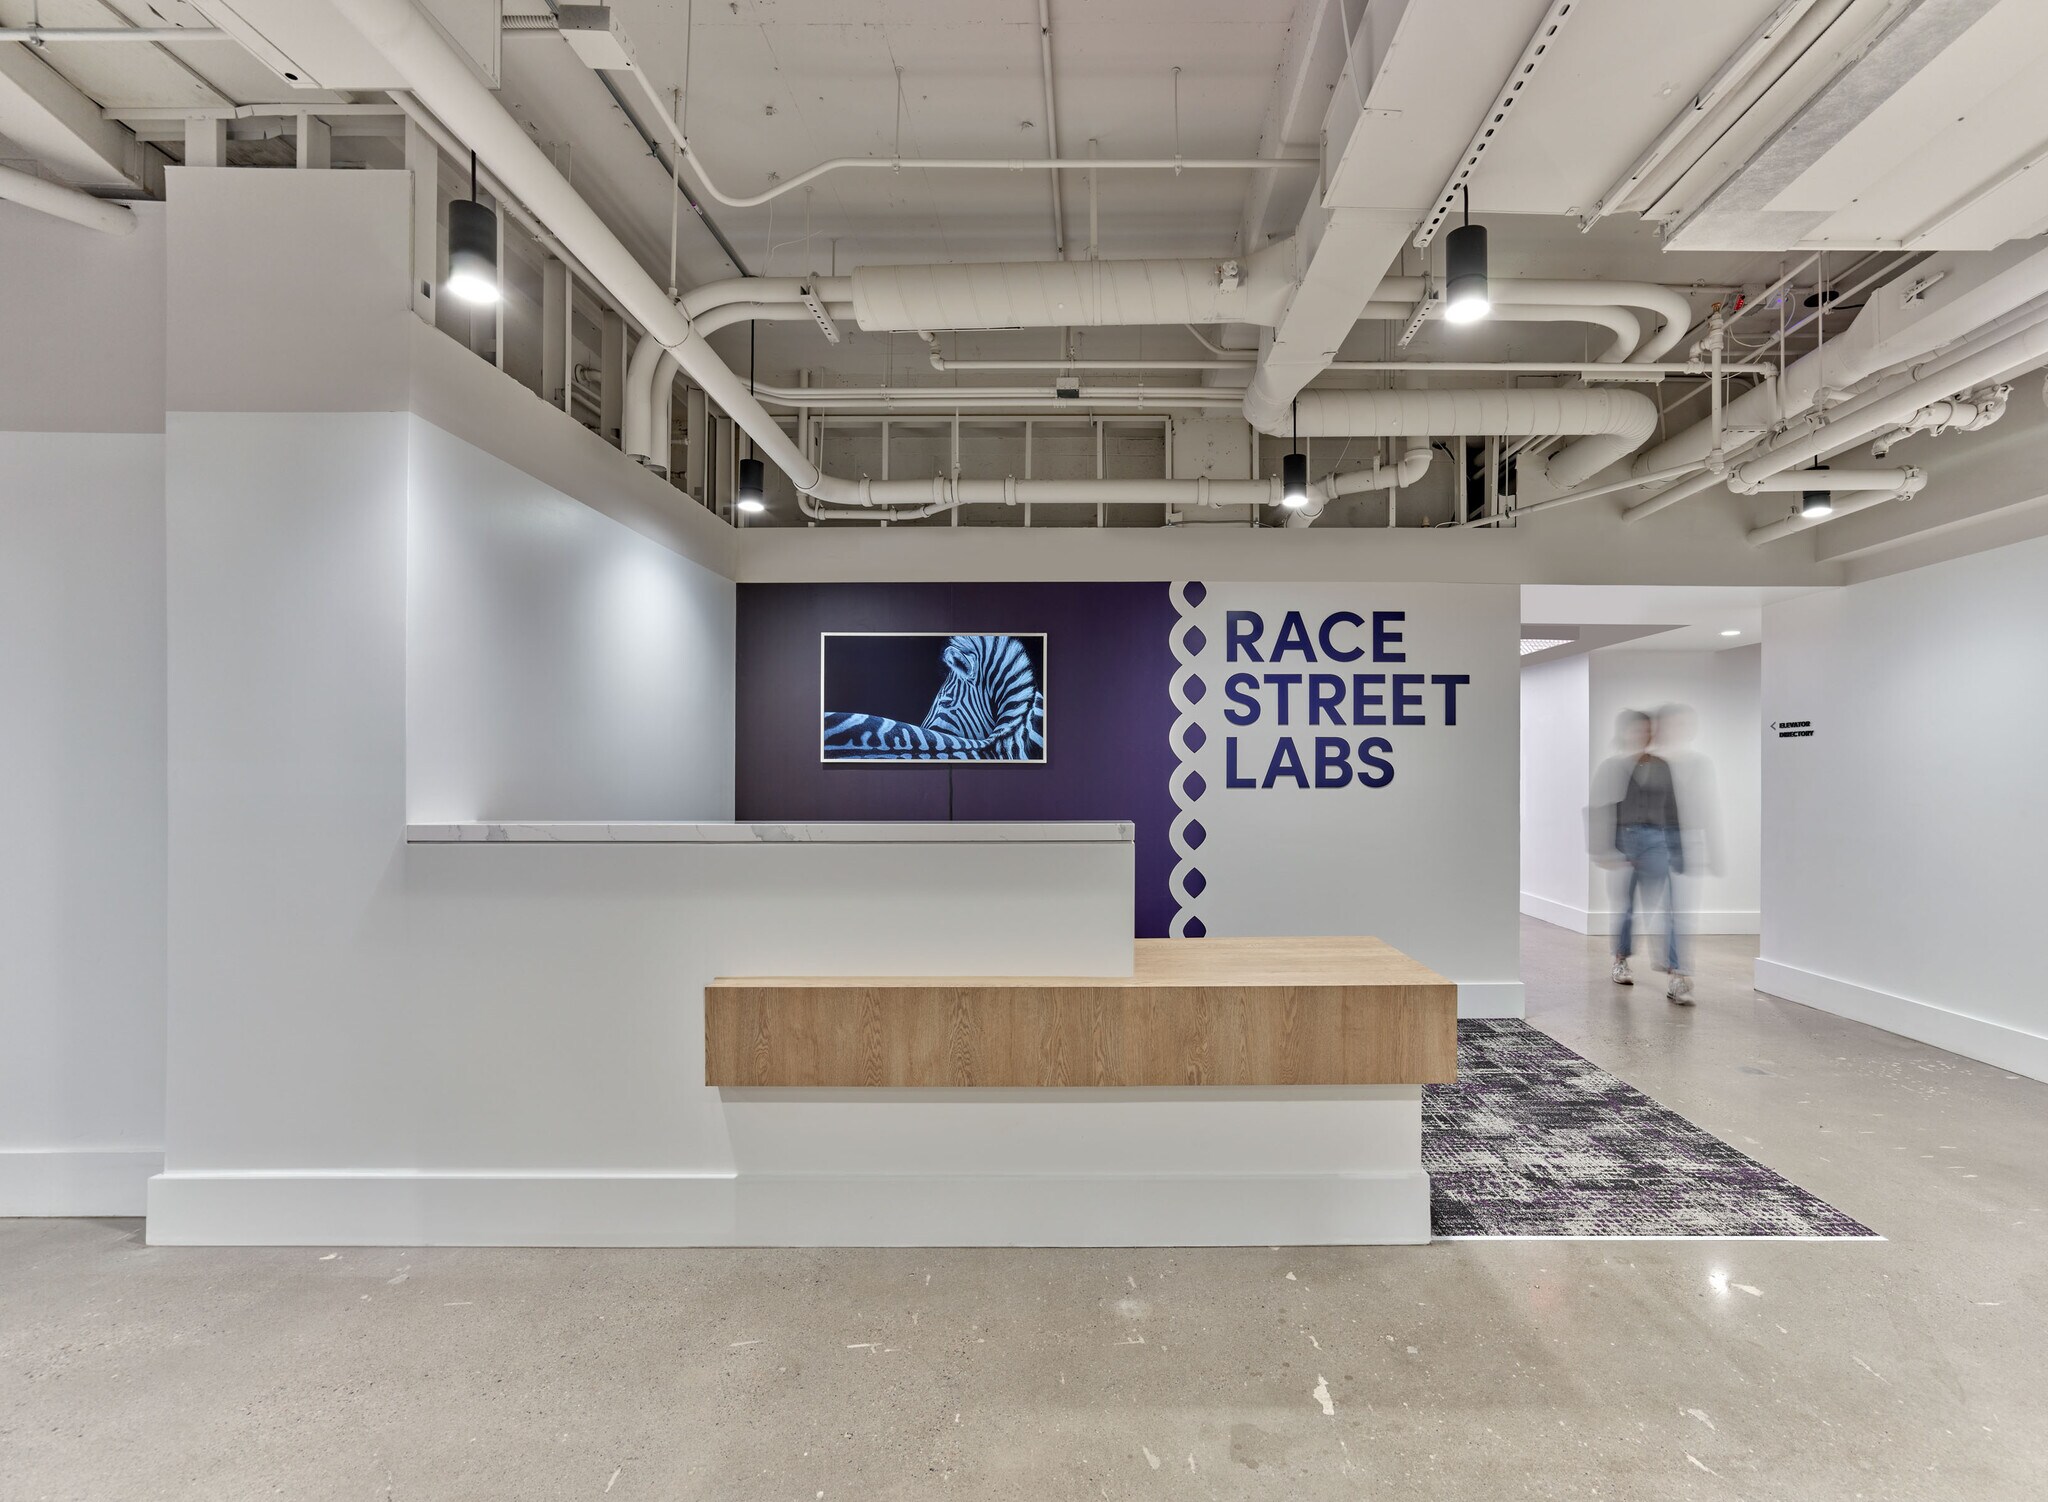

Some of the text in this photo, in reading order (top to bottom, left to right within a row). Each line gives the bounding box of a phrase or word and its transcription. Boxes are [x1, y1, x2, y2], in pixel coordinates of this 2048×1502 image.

[1226, 611, 1406, 662] RACE
[1223, 672, 1470, 726] STREET
[1779, 730, 1814, 738] DIRECTORY
[1226, 736, 1395, 789] LABS
